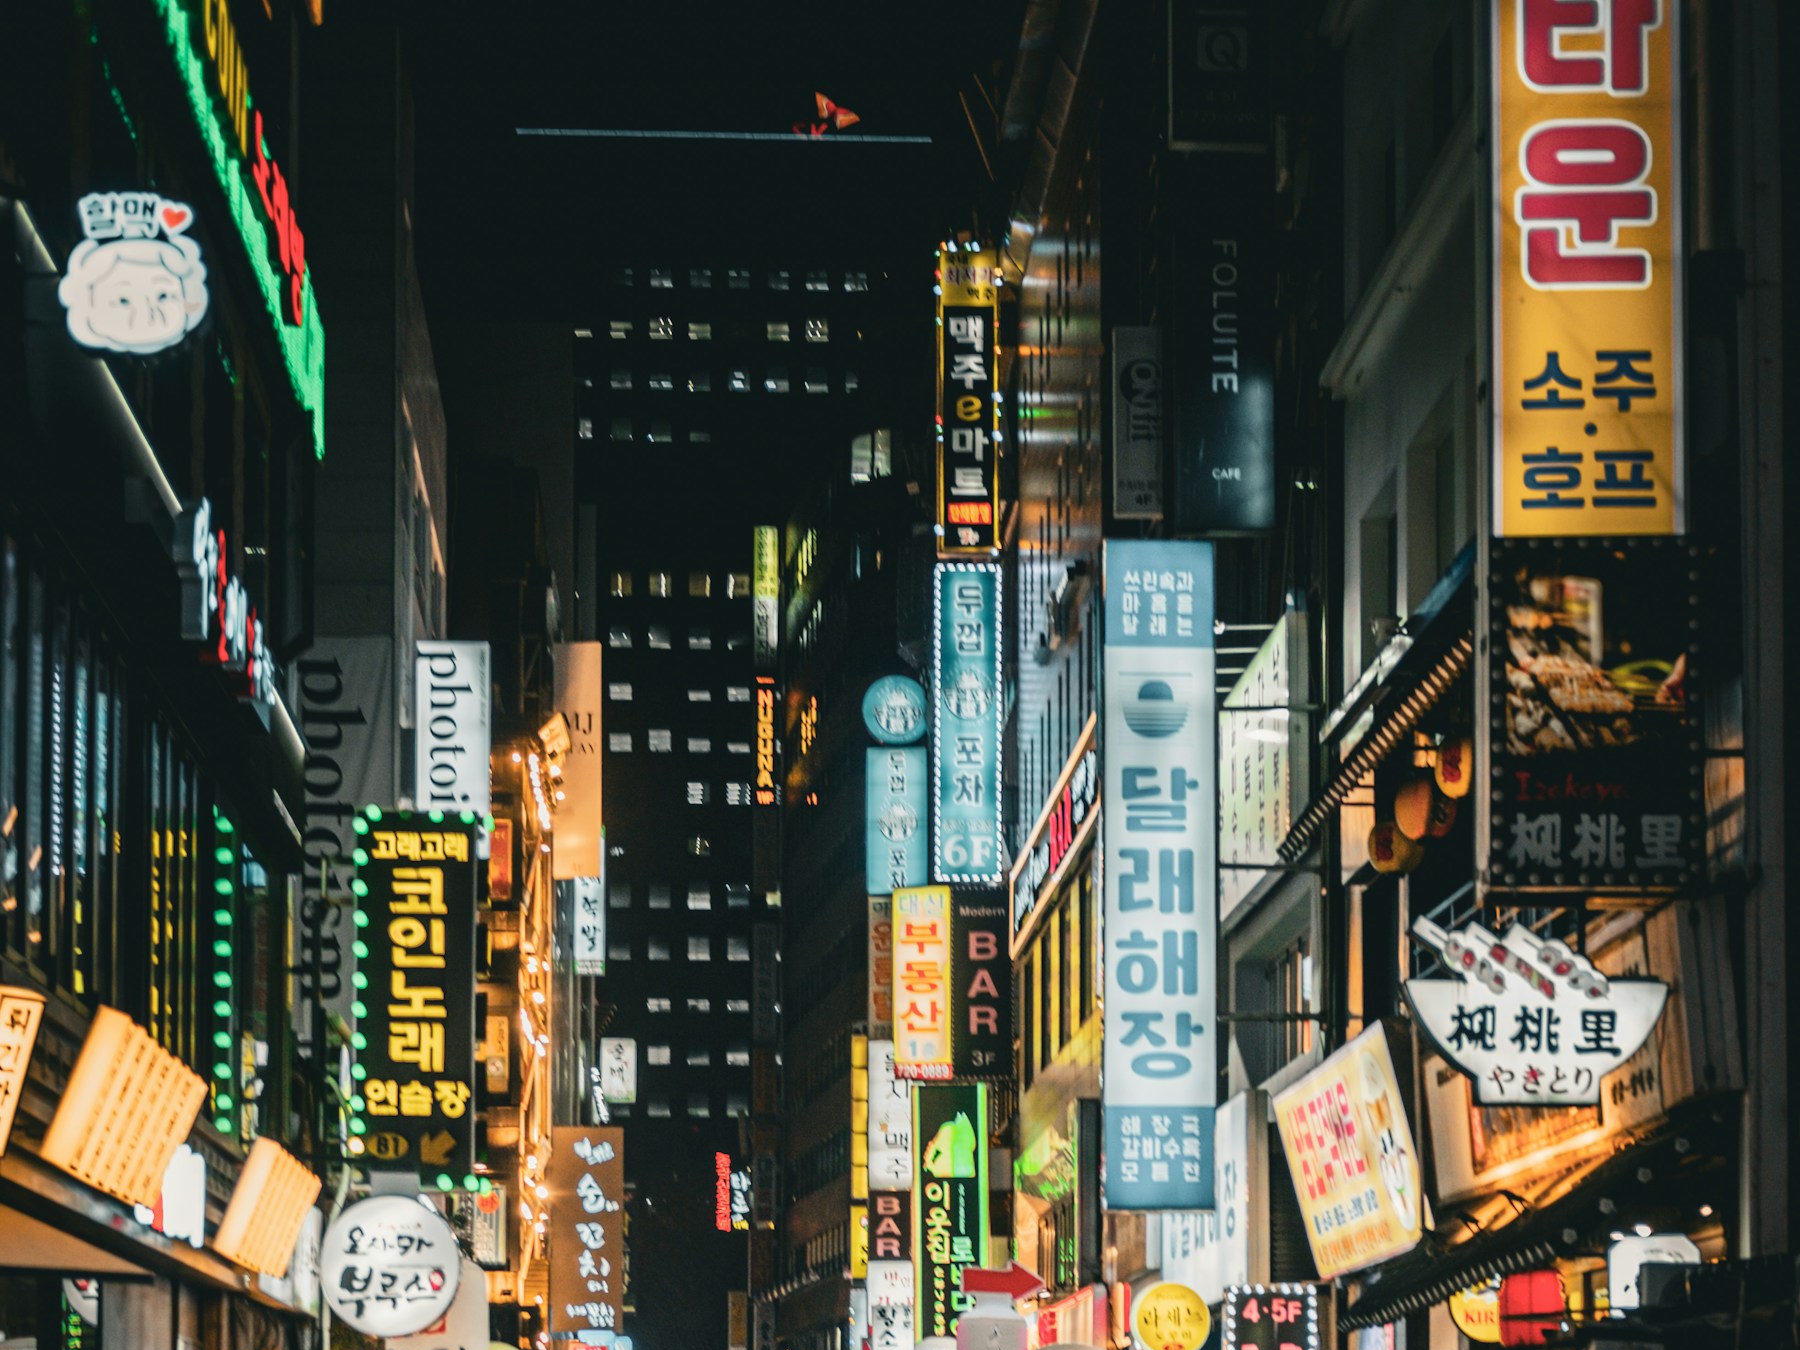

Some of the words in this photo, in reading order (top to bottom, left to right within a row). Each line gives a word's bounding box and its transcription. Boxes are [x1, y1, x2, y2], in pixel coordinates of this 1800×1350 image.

[1211, 239, 1239, 394] FOLUITE
[948, 316, 989, 497] 맥주e마트
[1521, 351, 1656, 412] 소주
[1212, 467, 1241, 481] CAFE
[1521, 447, 1656, 508] 호프
[371, 831, 470, 862] 고래고래
[944, 834, 993, 868] 6F
[959, 905, 1005, 917] Modern
[1117, 766, 1200, 1079] 달래해장
[388, 867, 448, 1073] 코인노래
[901, 922, 943, 1032] 부동산
[967, 931, 999, 1035] BAR
[971, 1050, 996, 1066] 3F
[1488, 1064, 1594, 1097] やきとり
[364, 1079, 471, 1119] 연습장
[876, 1197, 901, 1260] BAR
